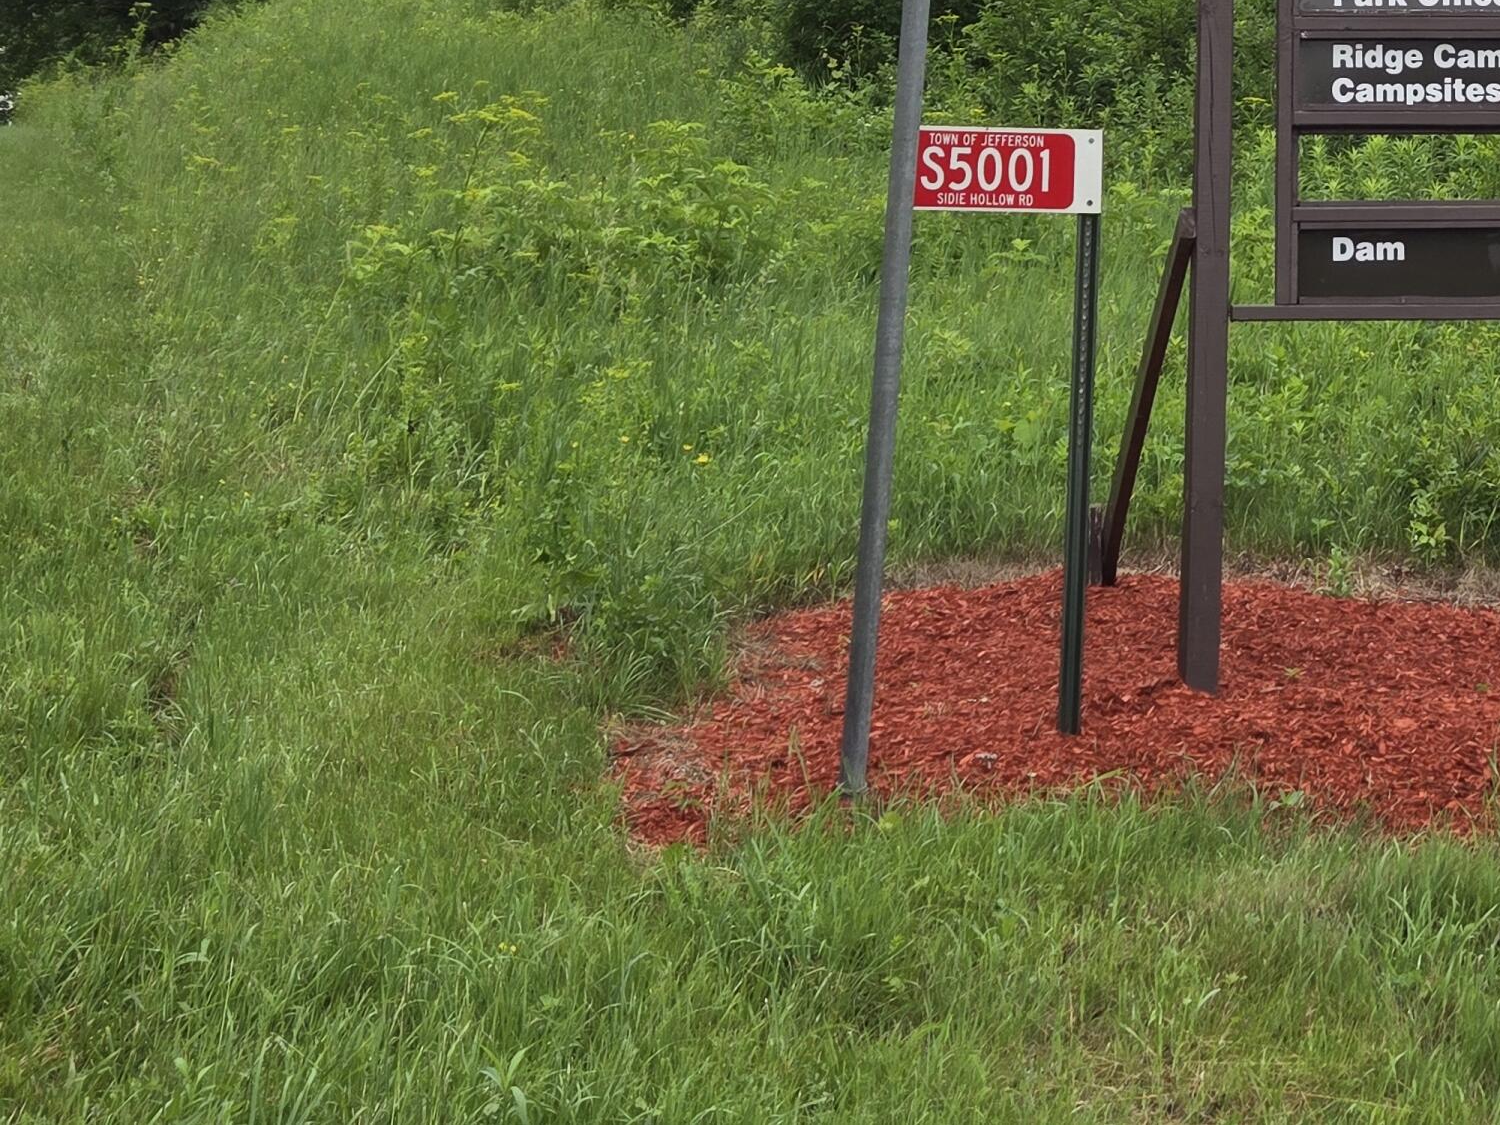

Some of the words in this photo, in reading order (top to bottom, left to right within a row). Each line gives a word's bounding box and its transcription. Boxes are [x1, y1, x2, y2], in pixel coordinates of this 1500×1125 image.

[1331, 44, 1423, 75] Ridge
[929, 132, 958, 145] TOWN
[963, 133, 977, 145] OF
[981, 134, 1044, 148] JEFFERSON
[920, 145, 1050, 193] S5001
[937, 192, 966, 205] SIDIE
[970, 193, 1014, 206] HOLLOW
[1019, 194, 1034, 206] RD
[1332, 237, 1406, 262] Dam
